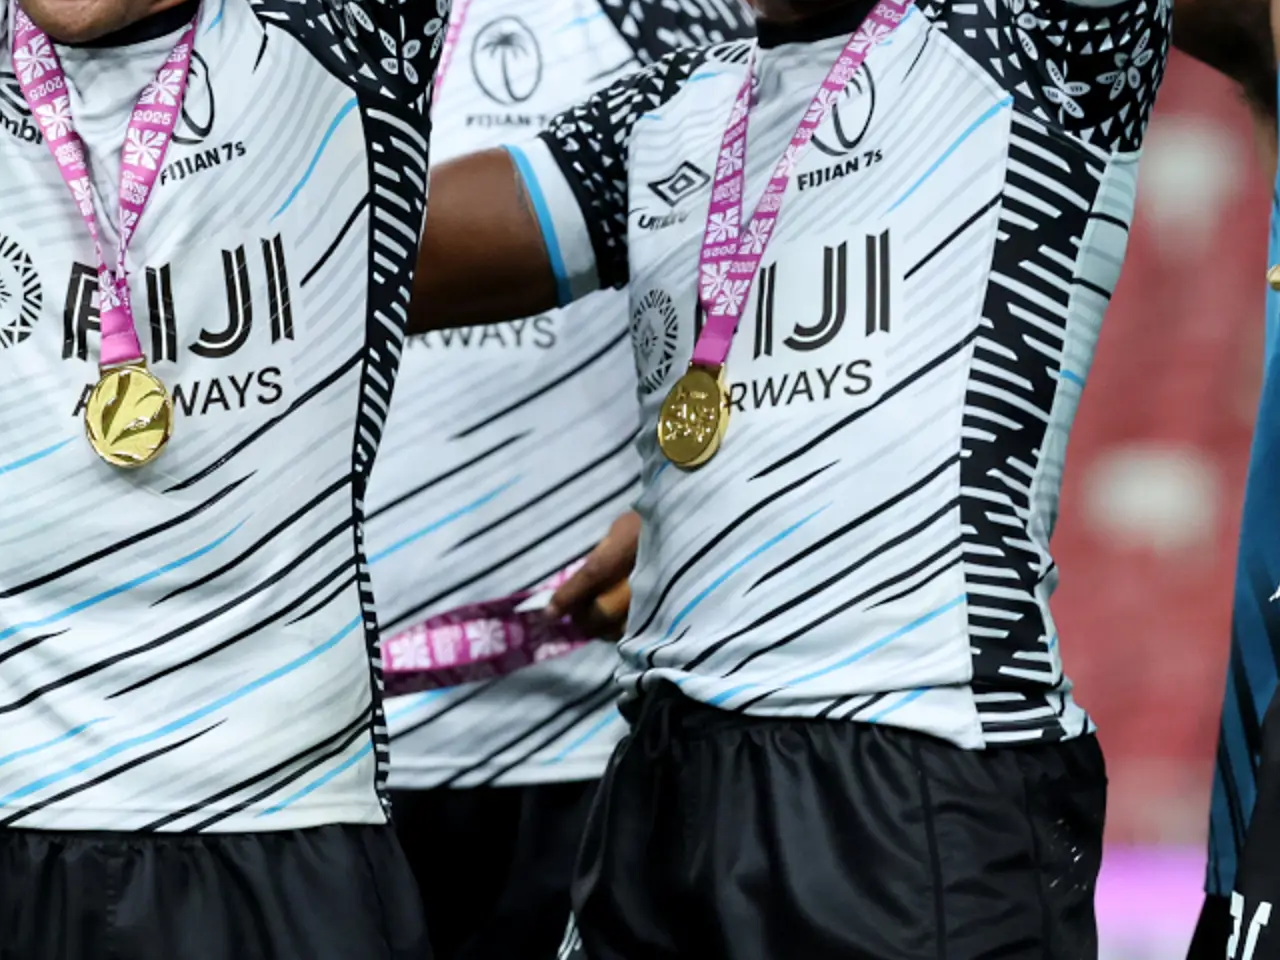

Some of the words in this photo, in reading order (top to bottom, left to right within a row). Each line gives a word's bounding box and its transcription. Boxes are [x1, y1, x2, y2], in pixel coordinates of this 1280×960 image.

[132, 109, 173, 126] 2025
[160, 147, 220, 186] FIJIAN
[222, 141, 247, 161] 7s
[796, 155, 860, 192] FIJIAN
[863, 148, 884, 170] 7s
[752, 227, 891, 361] IJI
